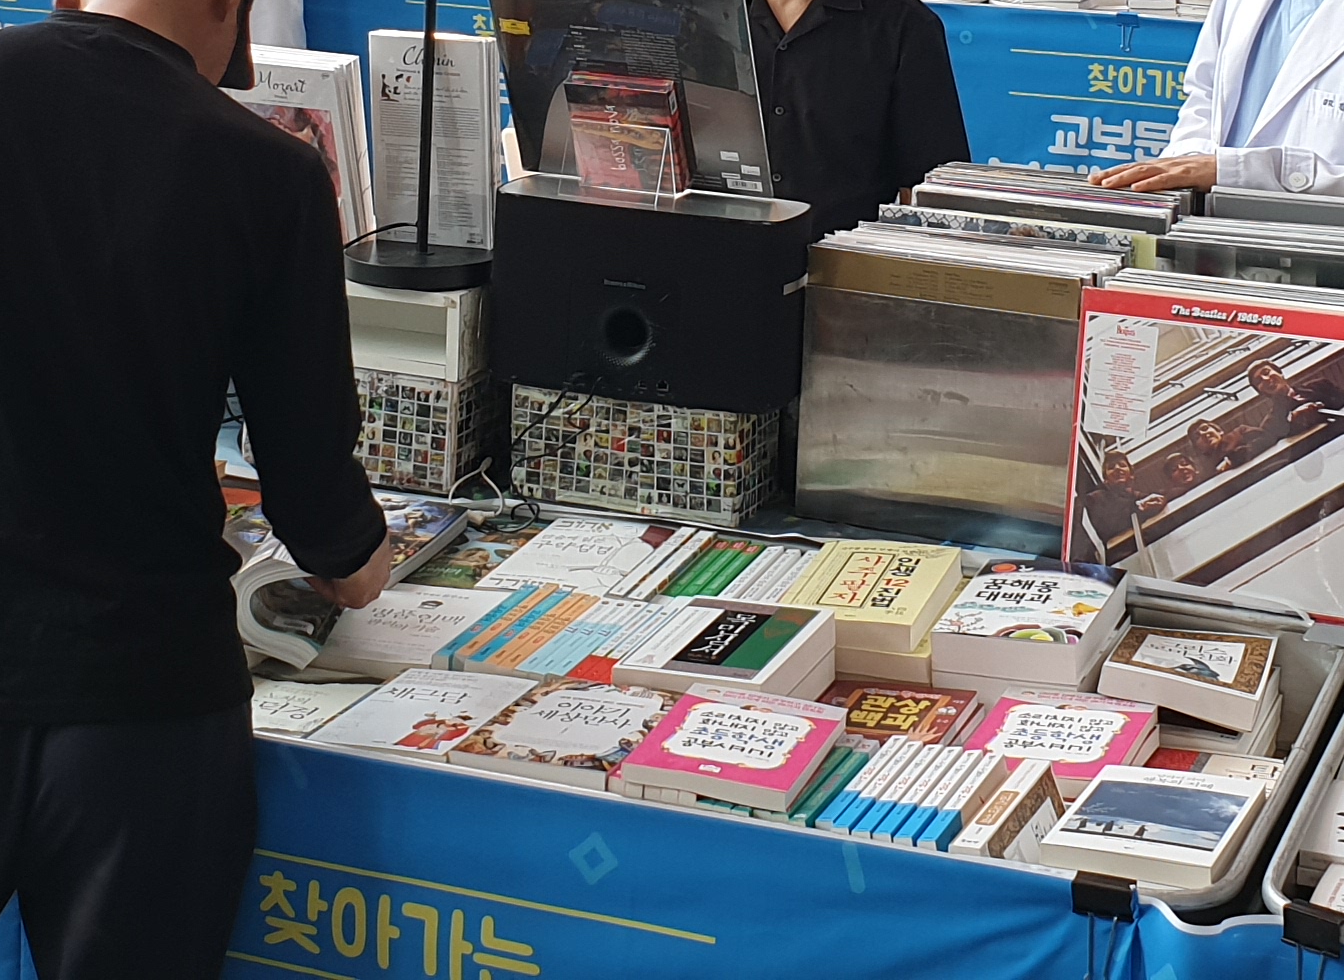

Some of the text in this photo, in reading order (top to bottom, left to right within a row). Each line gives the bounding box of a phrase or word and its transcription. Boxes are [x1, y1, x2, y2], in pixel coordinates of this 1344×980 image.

[254, 70, 307, 95] Mozart
[1047, 113, 1178, 162] 교보문
[1171, 304, 1191, 318] The
[1191, 307, 1228, 322] Beatles
[983, 578, 1061, 594] 꿈해몽
[974, 590, 1053, 605] 대백과
[378, 685, 473, 706] 채근담
[860, 695, 931, 715] 관상
[556, 700, 631, 719] 이야기
[849, 711, 919, 731] 백과
[689, 726, 785, 751] 초등학생
[1009, 728, 1102, 745] 초등학생
[259, 870, 541, 980] 찾아가는
